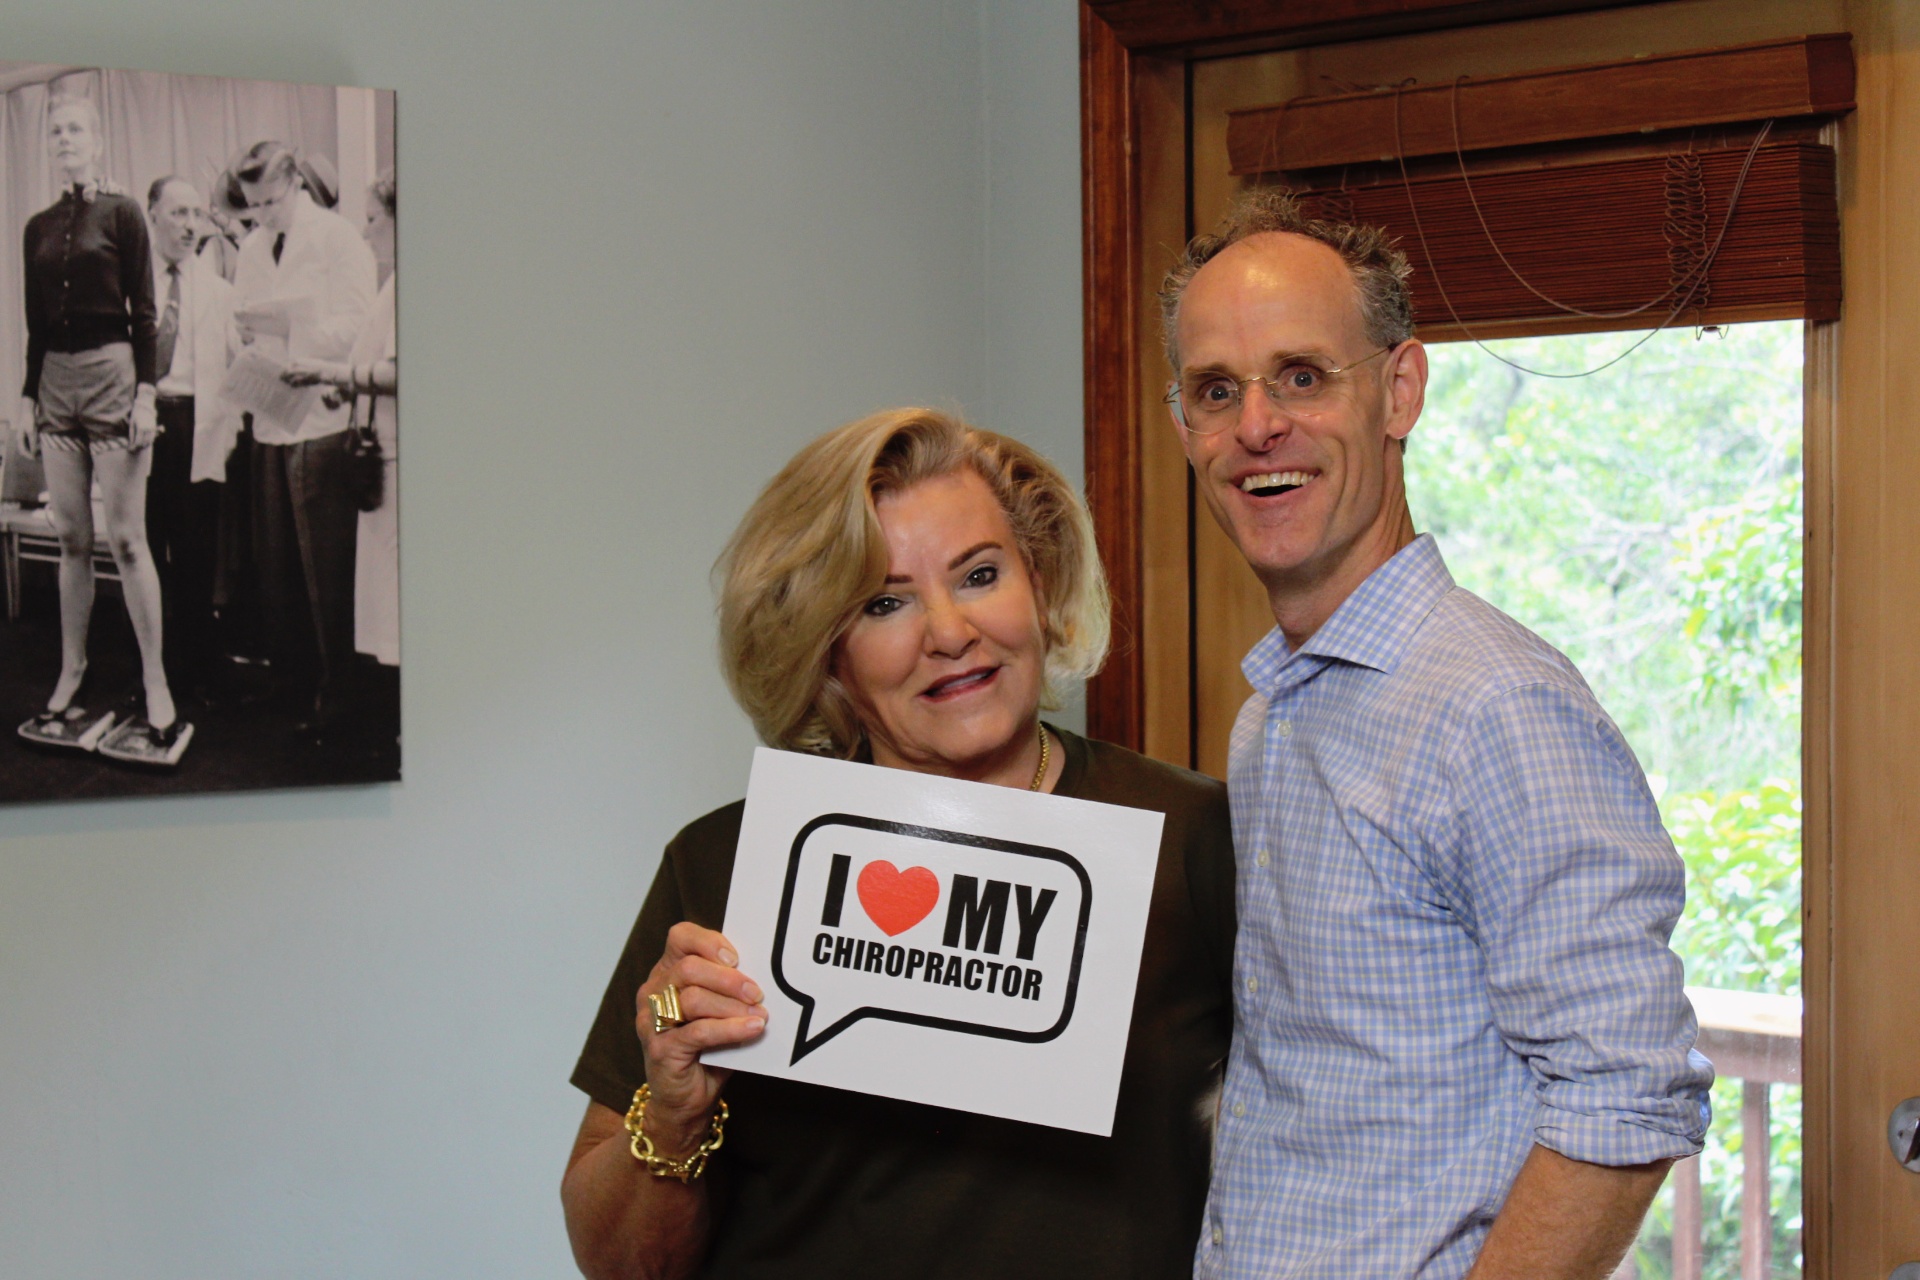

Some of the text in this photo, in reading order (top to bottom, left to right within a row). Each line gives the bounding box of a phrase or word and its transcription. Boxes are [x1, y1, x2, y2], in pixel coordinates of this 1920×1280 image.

[820, 853, 1058, 961] I MY
[812, 932, 1043, 1001] CHIROPRACTOR
